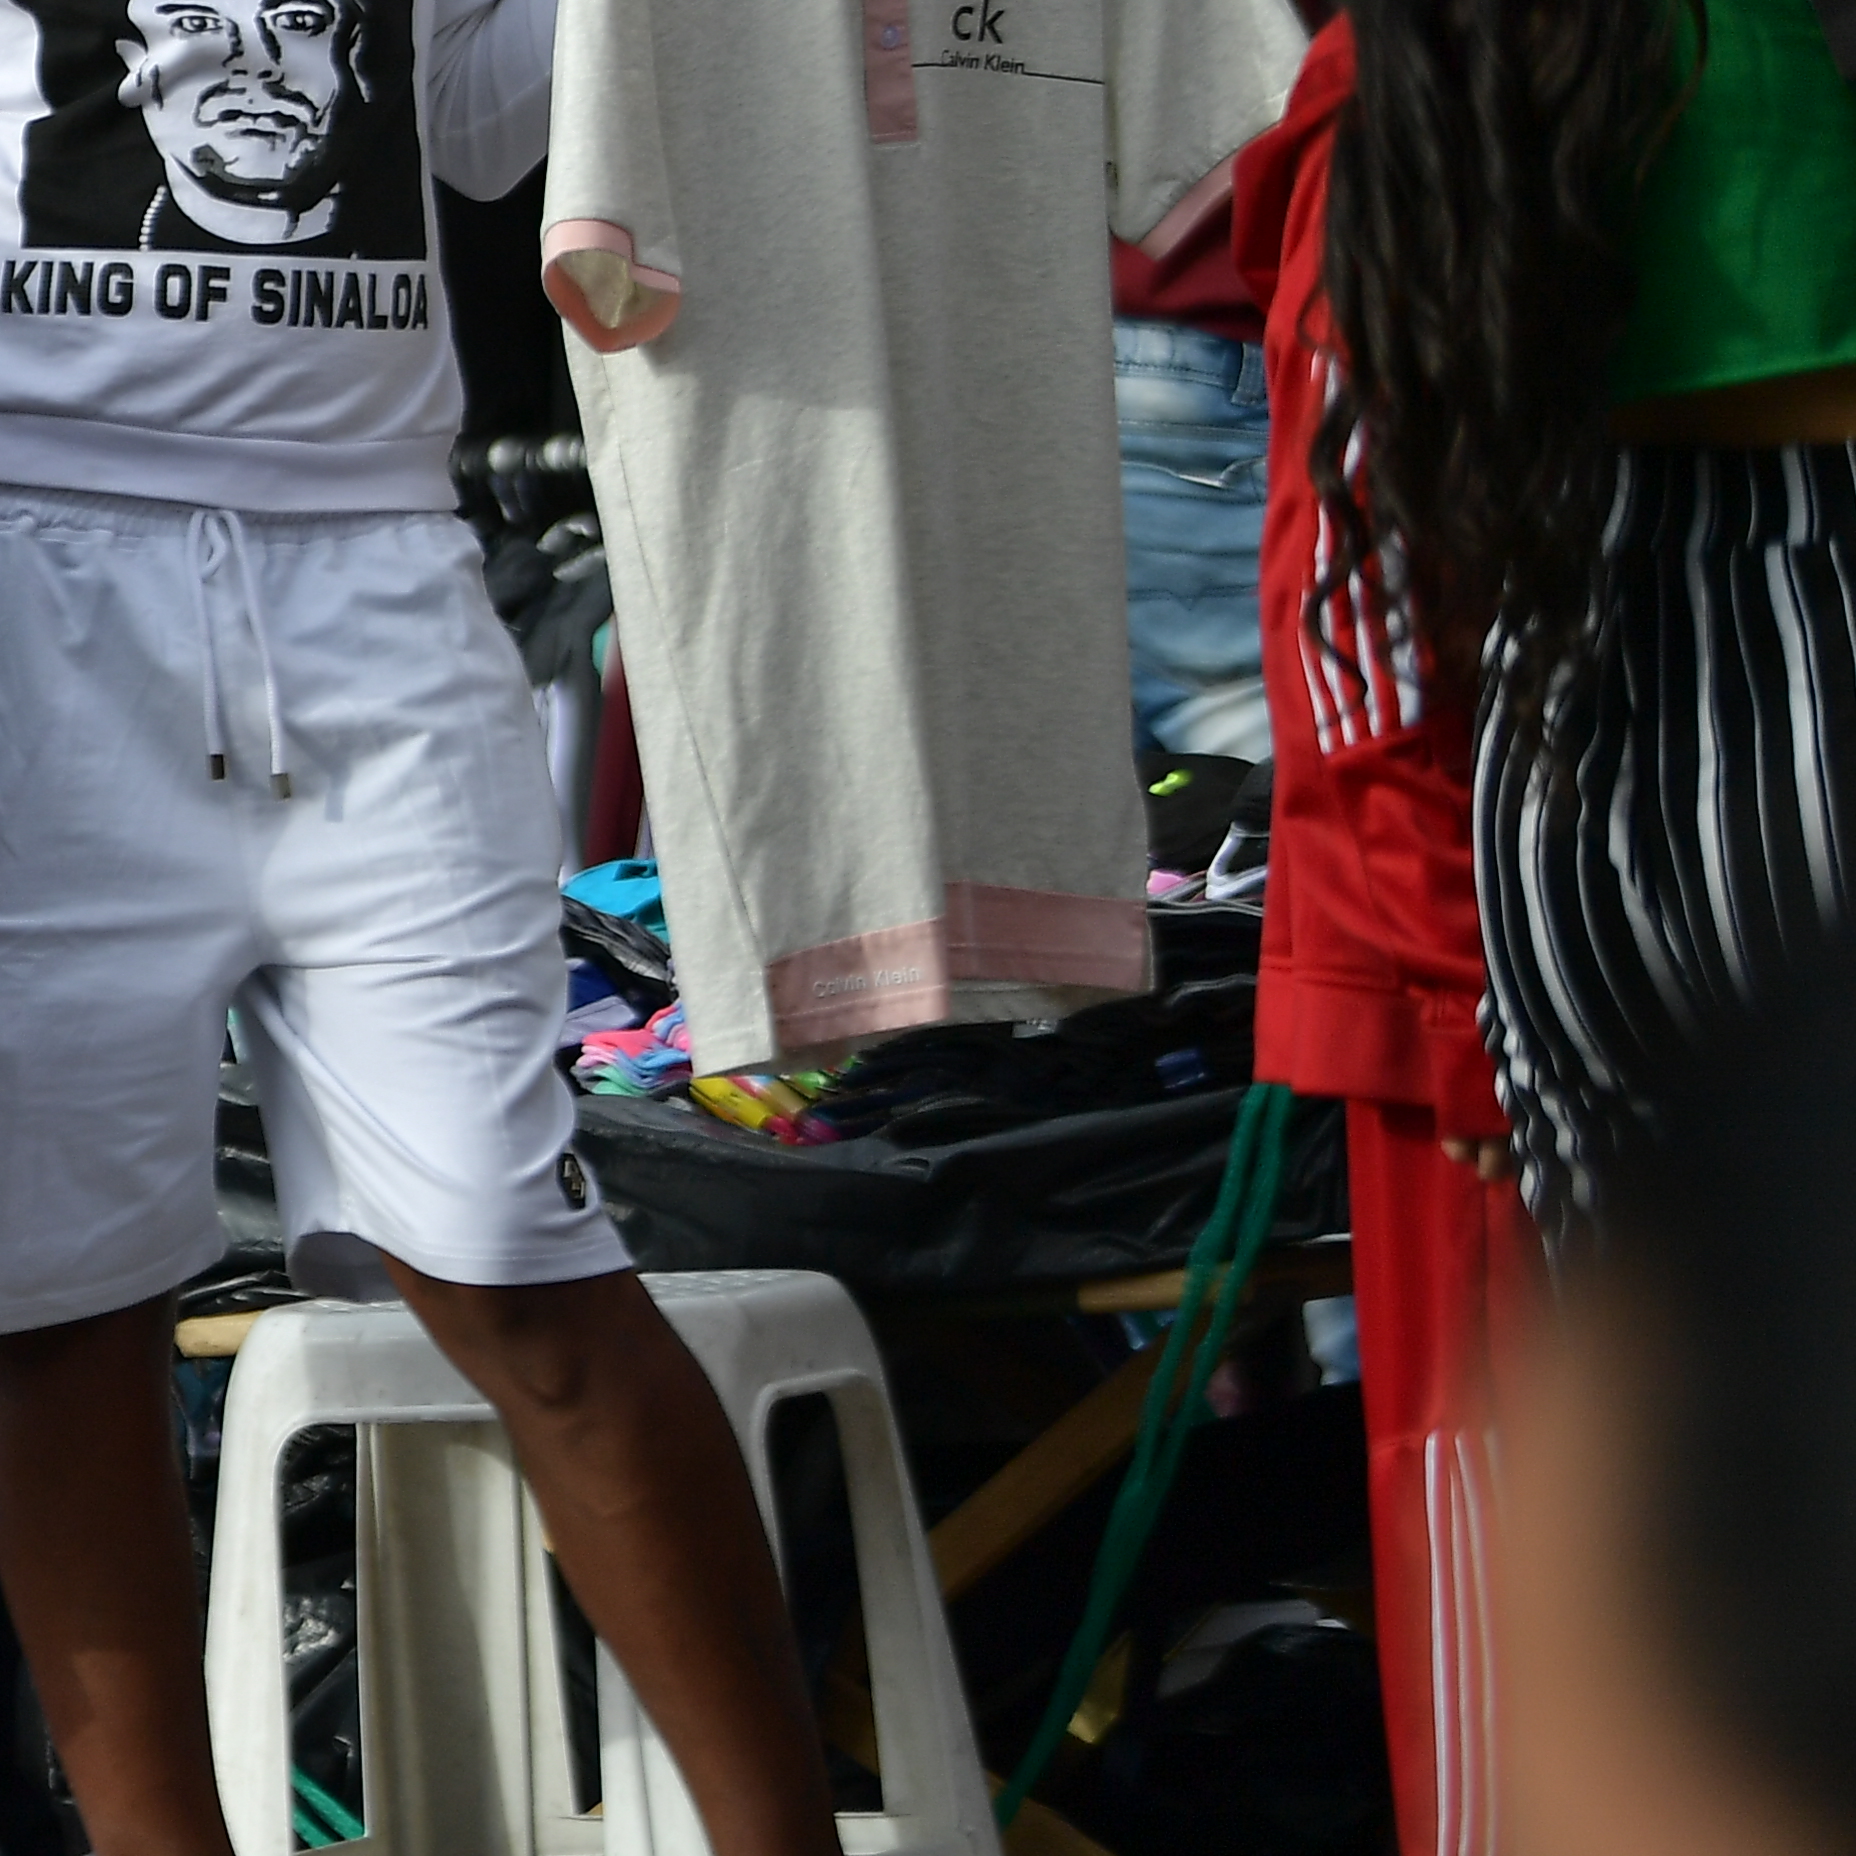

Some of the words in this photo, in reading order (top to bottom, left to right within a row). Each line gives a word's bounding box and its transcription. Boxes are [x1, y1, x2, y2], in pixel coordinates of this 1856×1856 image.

[940, 49, 980, 70] Calvin
[984, 53, 1025, 75] Klein
[0, 259, 136, 318] KING
[154, 262, 232, 323] OF
[250, 266, 430, 332] SINALOA
